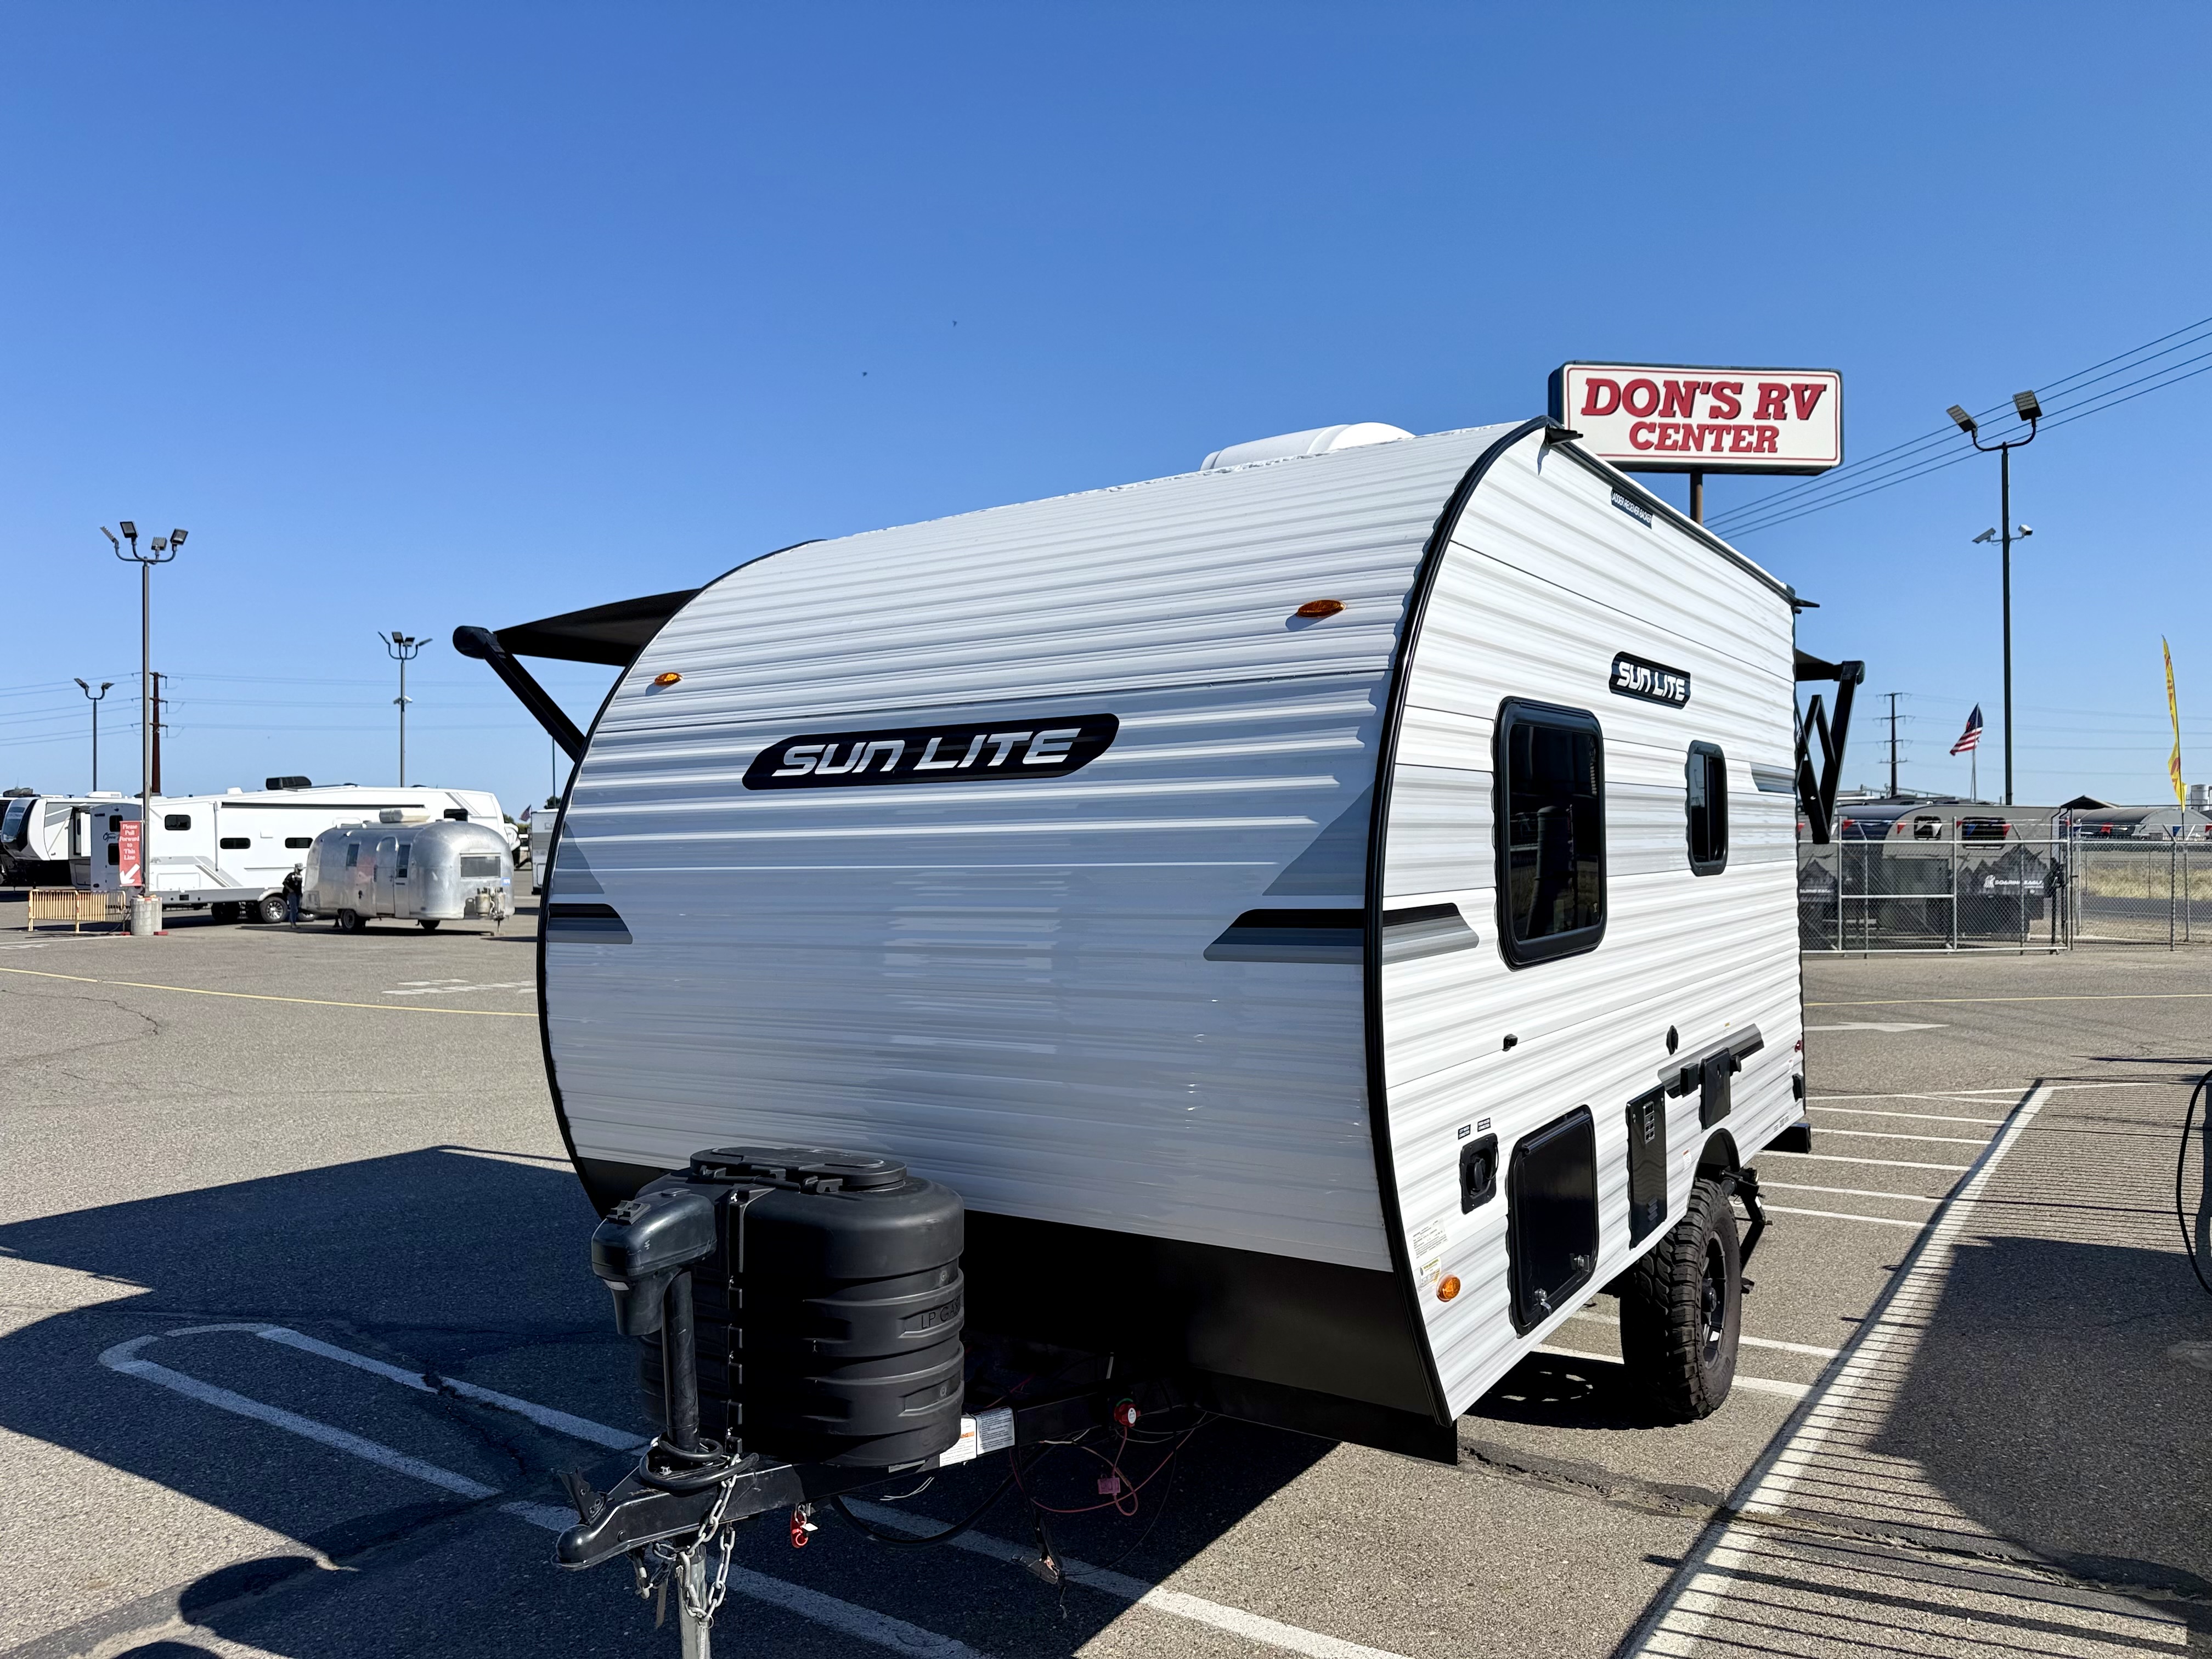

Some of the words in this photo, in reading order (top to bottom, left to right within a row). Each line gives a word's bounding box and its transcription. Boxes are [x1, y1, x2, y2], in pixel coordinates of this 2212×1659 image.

[1581, 378, 1743, 420] DON'S
[1753, 383, 1827, 421] RV
[1629, 421, 1780, 453] CENTER
[1617, 661, 1651, 693] SUN
[1652, 672, 1685, 702] LITE
[771, 739, 905, 777] SUN
[913, 727, 1082, 770] LITE
[921, 1312, 936, 1329] LP
